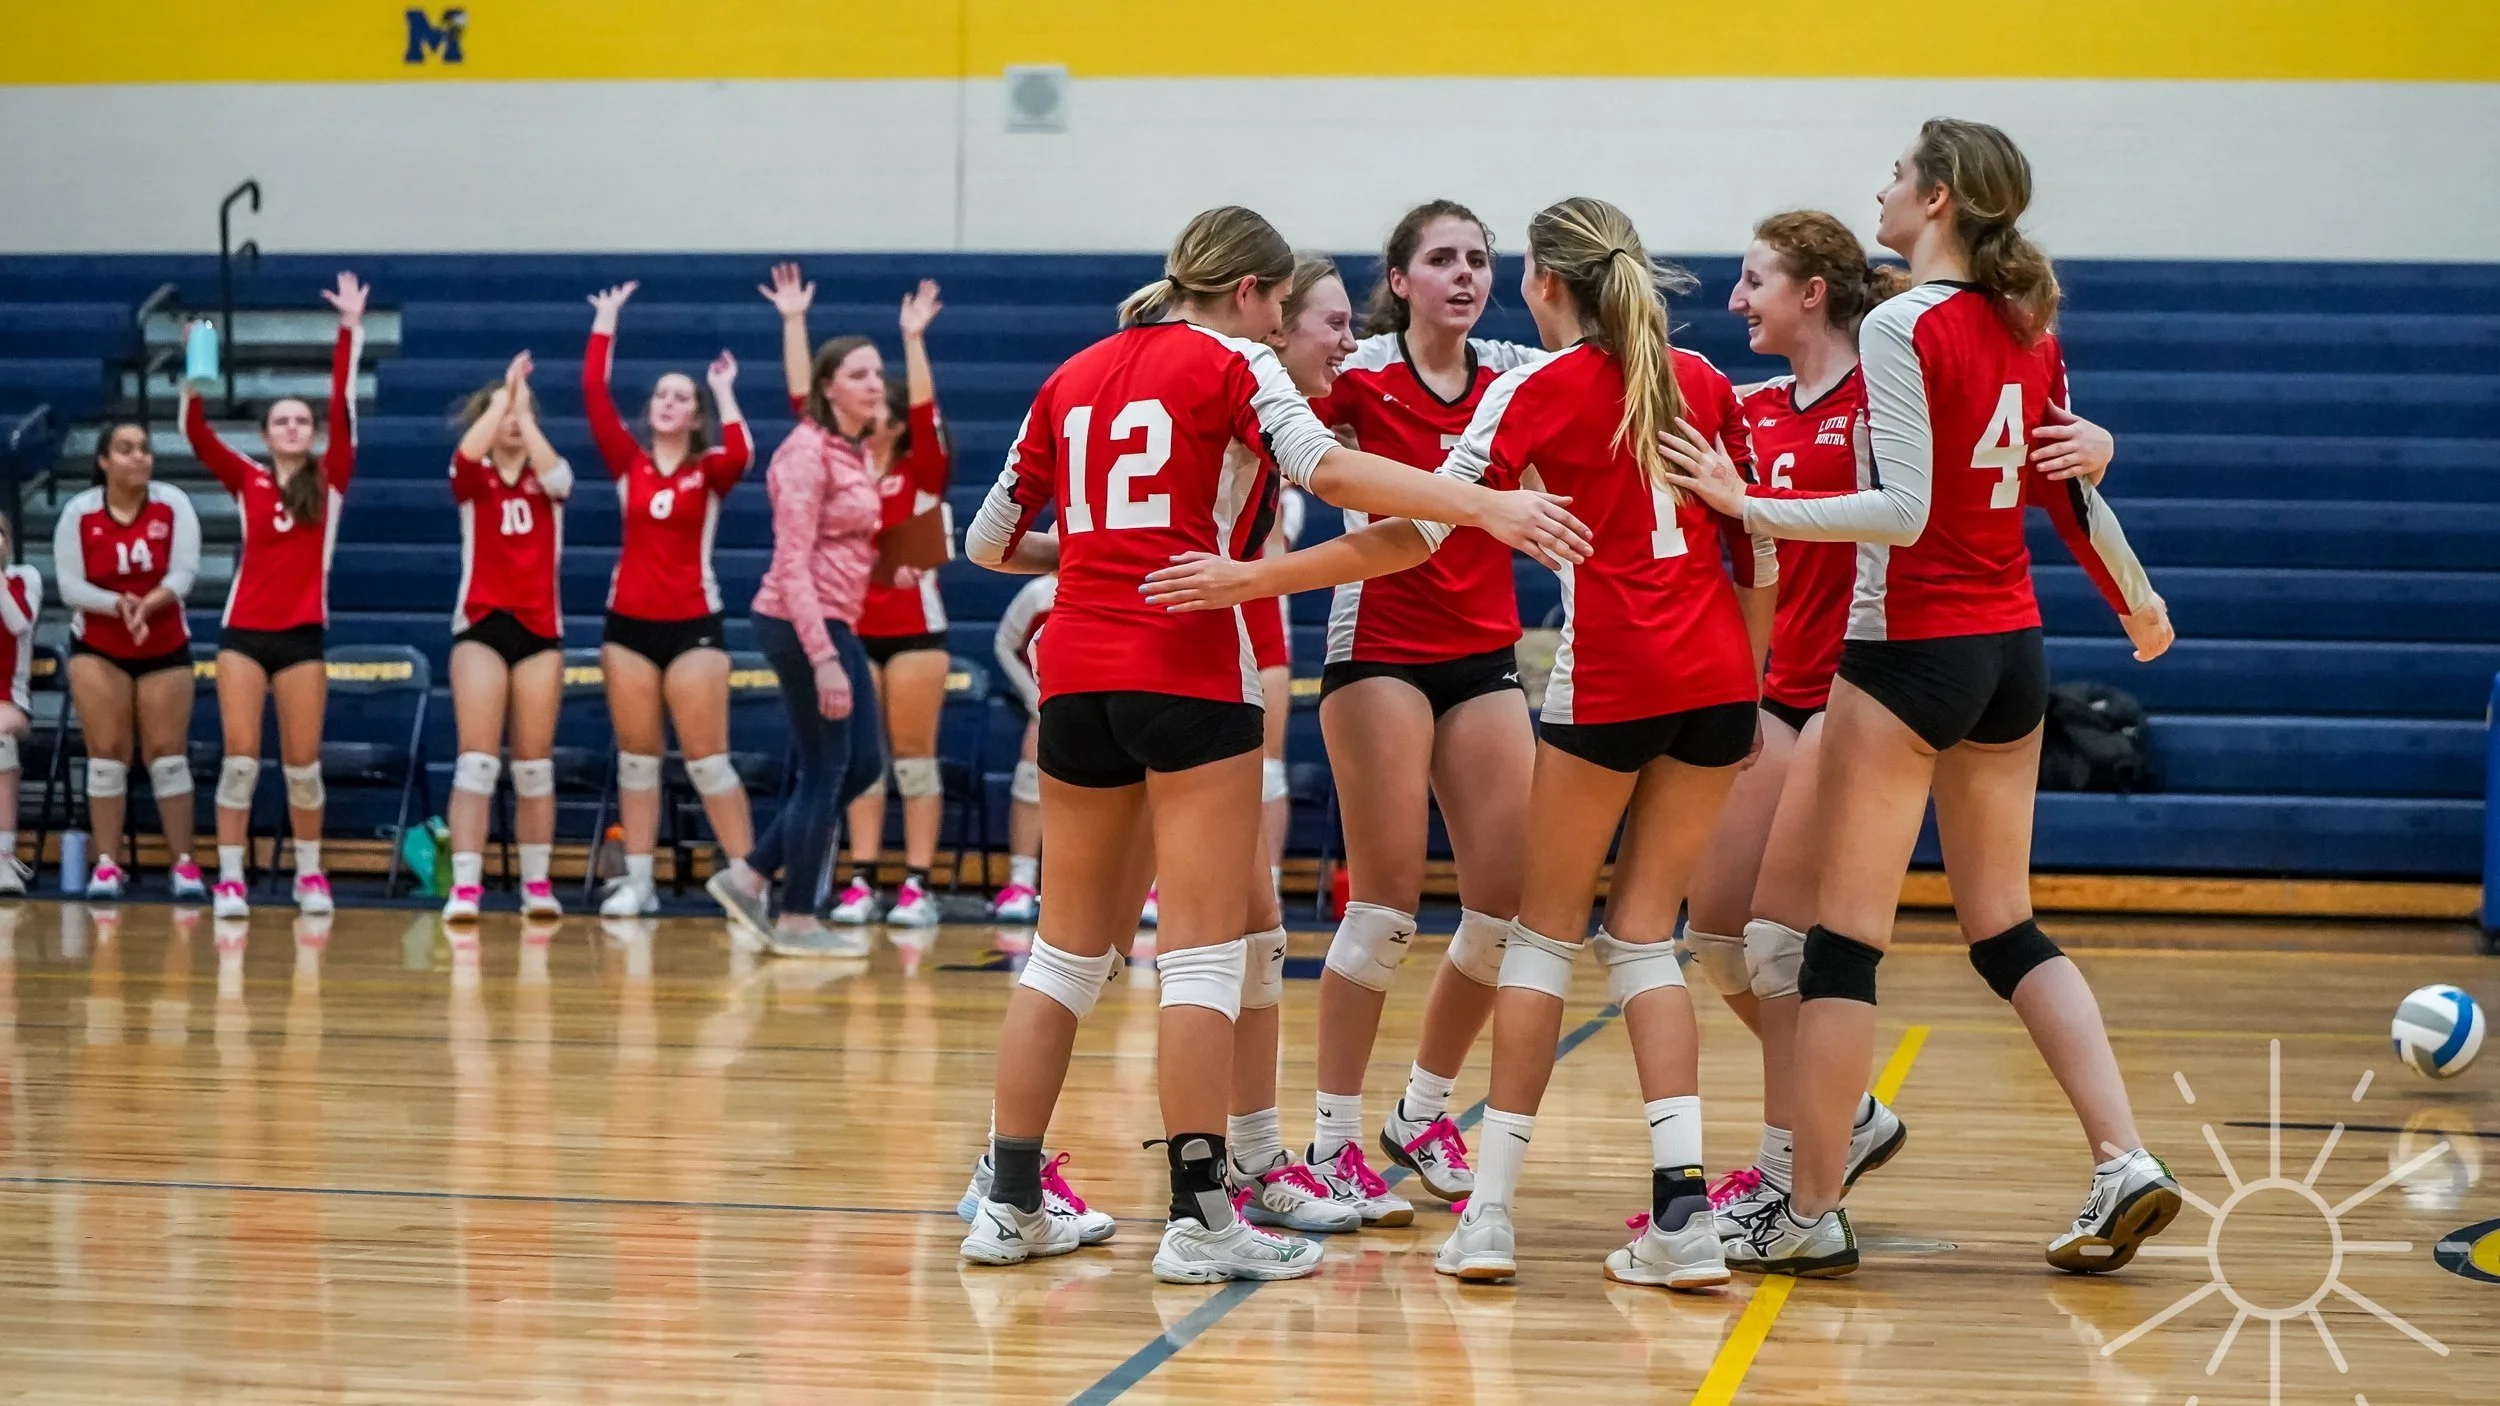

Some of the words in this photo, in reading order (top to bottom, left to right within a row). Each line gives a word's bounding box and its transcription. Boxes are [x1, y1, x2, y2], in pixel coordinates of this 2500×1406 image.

[405, 9, 465, 63] M
[1814, 433, 1847, 446] NORTHW
[1970, 383, 2028, 509] 4
[1063, 398, 1173, 535] 12
[1771, 452, 1795, 490] 6
[500, 497, 534, 536] 10
[115, 537, 153, 575] 14
